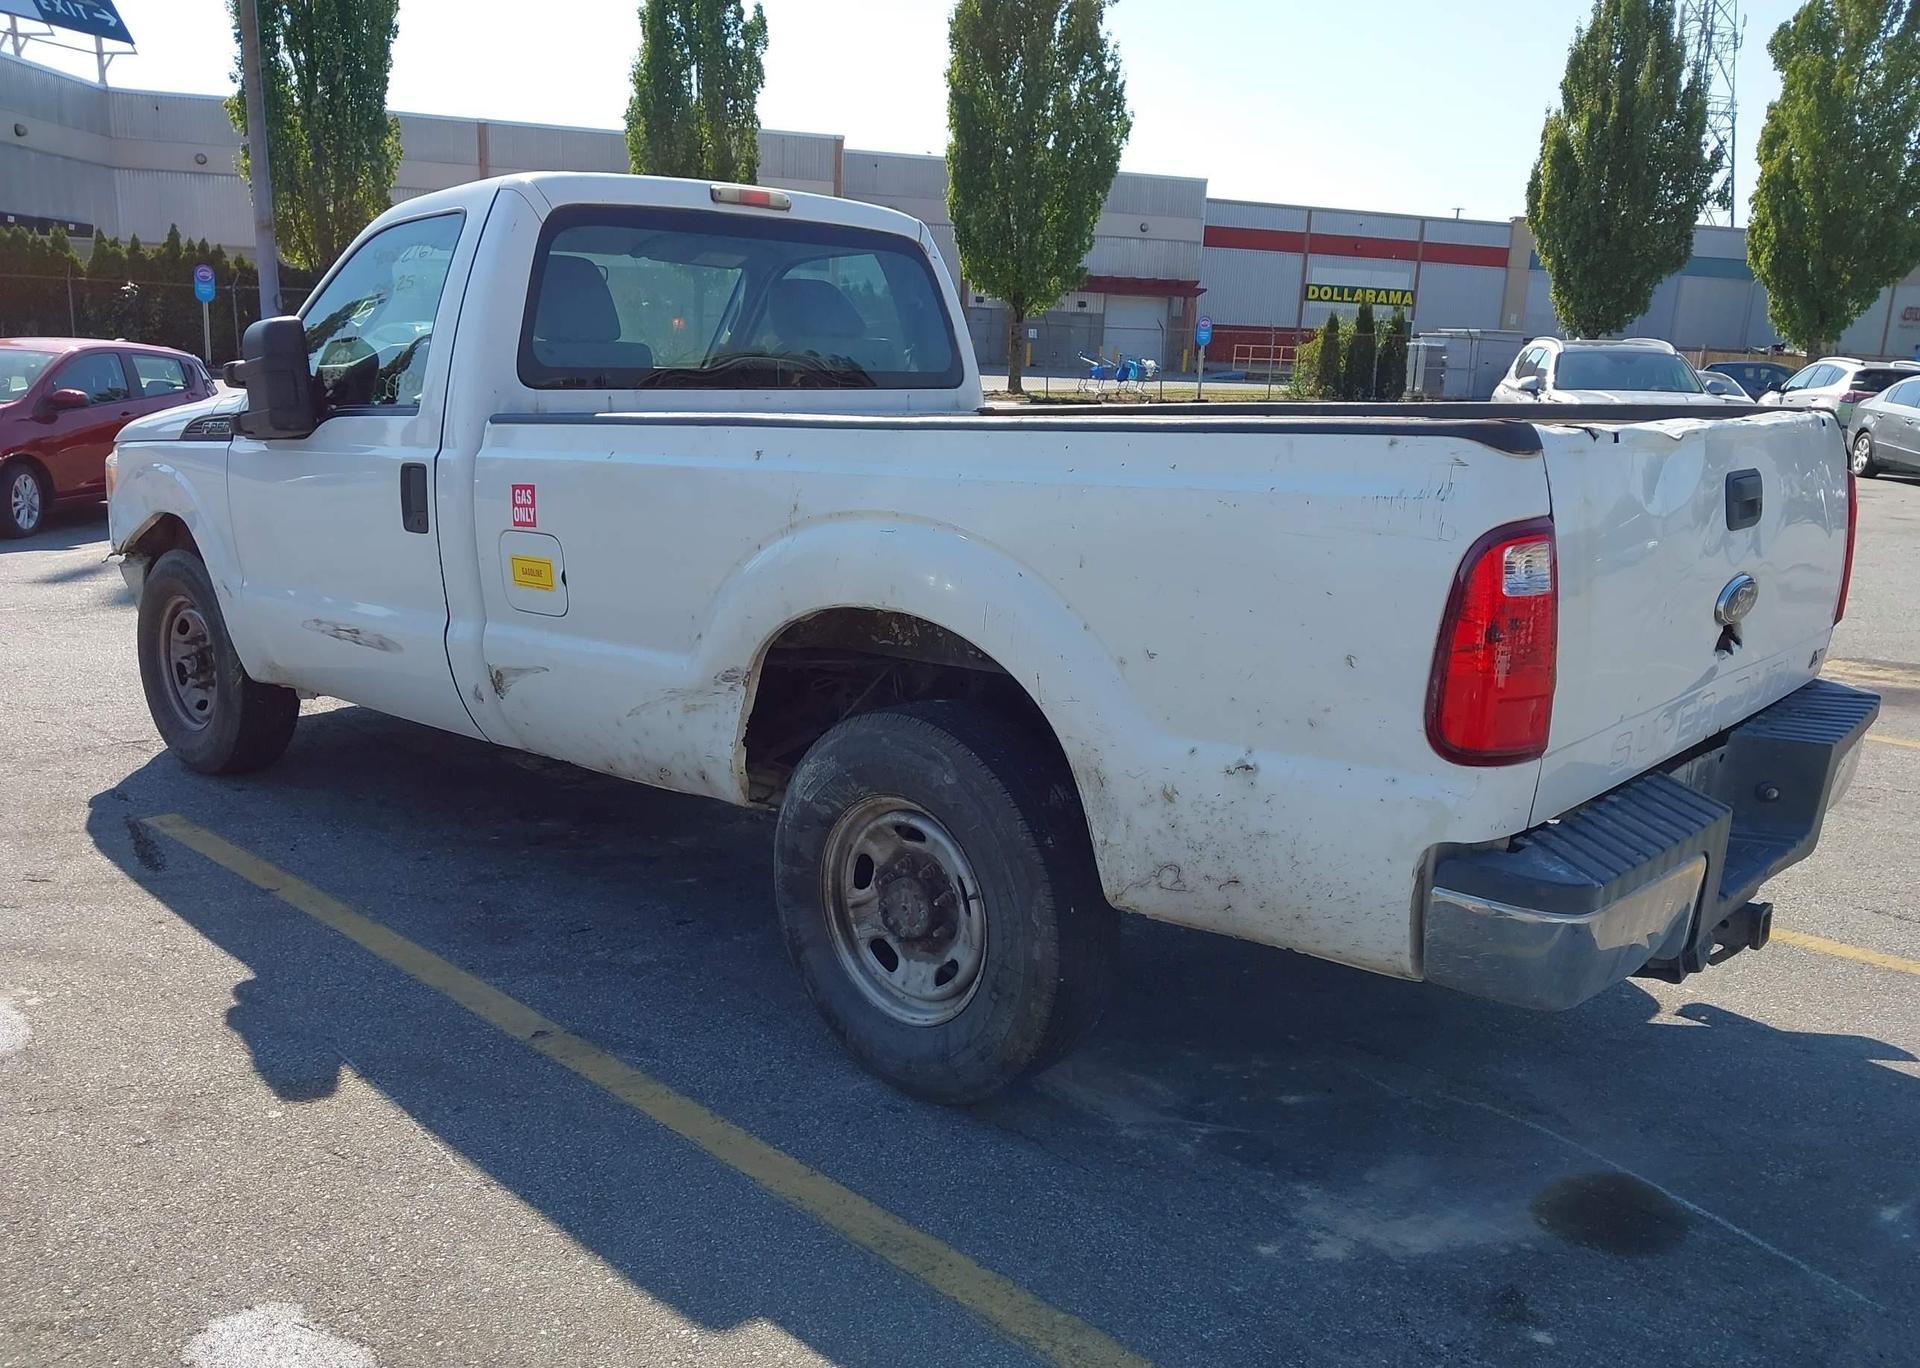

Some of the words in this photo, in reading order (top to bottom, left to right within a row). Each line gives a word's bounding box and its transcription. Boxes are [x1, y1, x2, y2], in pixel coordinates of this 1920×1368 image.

[39, 0, 88, 20] EXIT
[1308, 286, 1413, 305] DOLLARAMA
[515, 489, 532, 504] GAS
[513, 507, 536, 522] ONLY
[1609, 691, 1717, 775] SUPER
